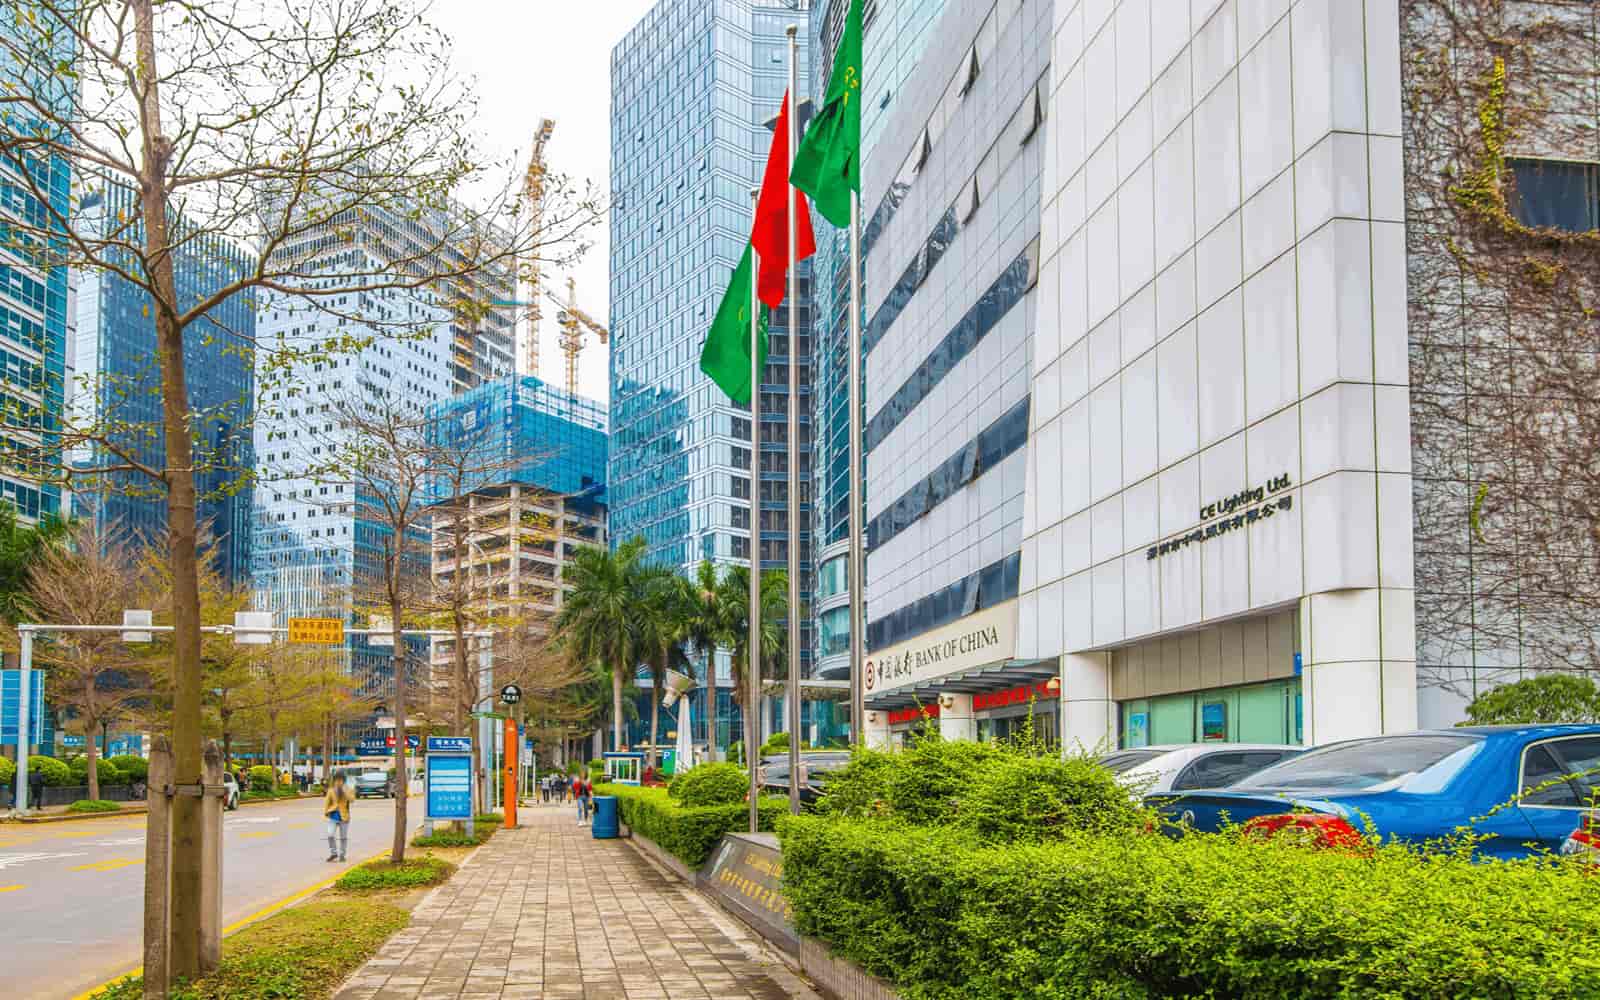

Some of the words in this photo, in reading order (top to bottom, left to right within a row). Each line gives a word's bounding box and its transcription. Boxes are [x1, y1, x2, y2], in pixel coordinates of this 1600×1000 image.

[1200, 505, 1215, 519] CE
[1217, 486, 1264, 512] Lighting
[1267, 472, 1291, 493] Ltd.
[915, 644, 941, 668] BANK
[943, 639, 957, 659] OF
[959, 625, 999, 654] CHINA
